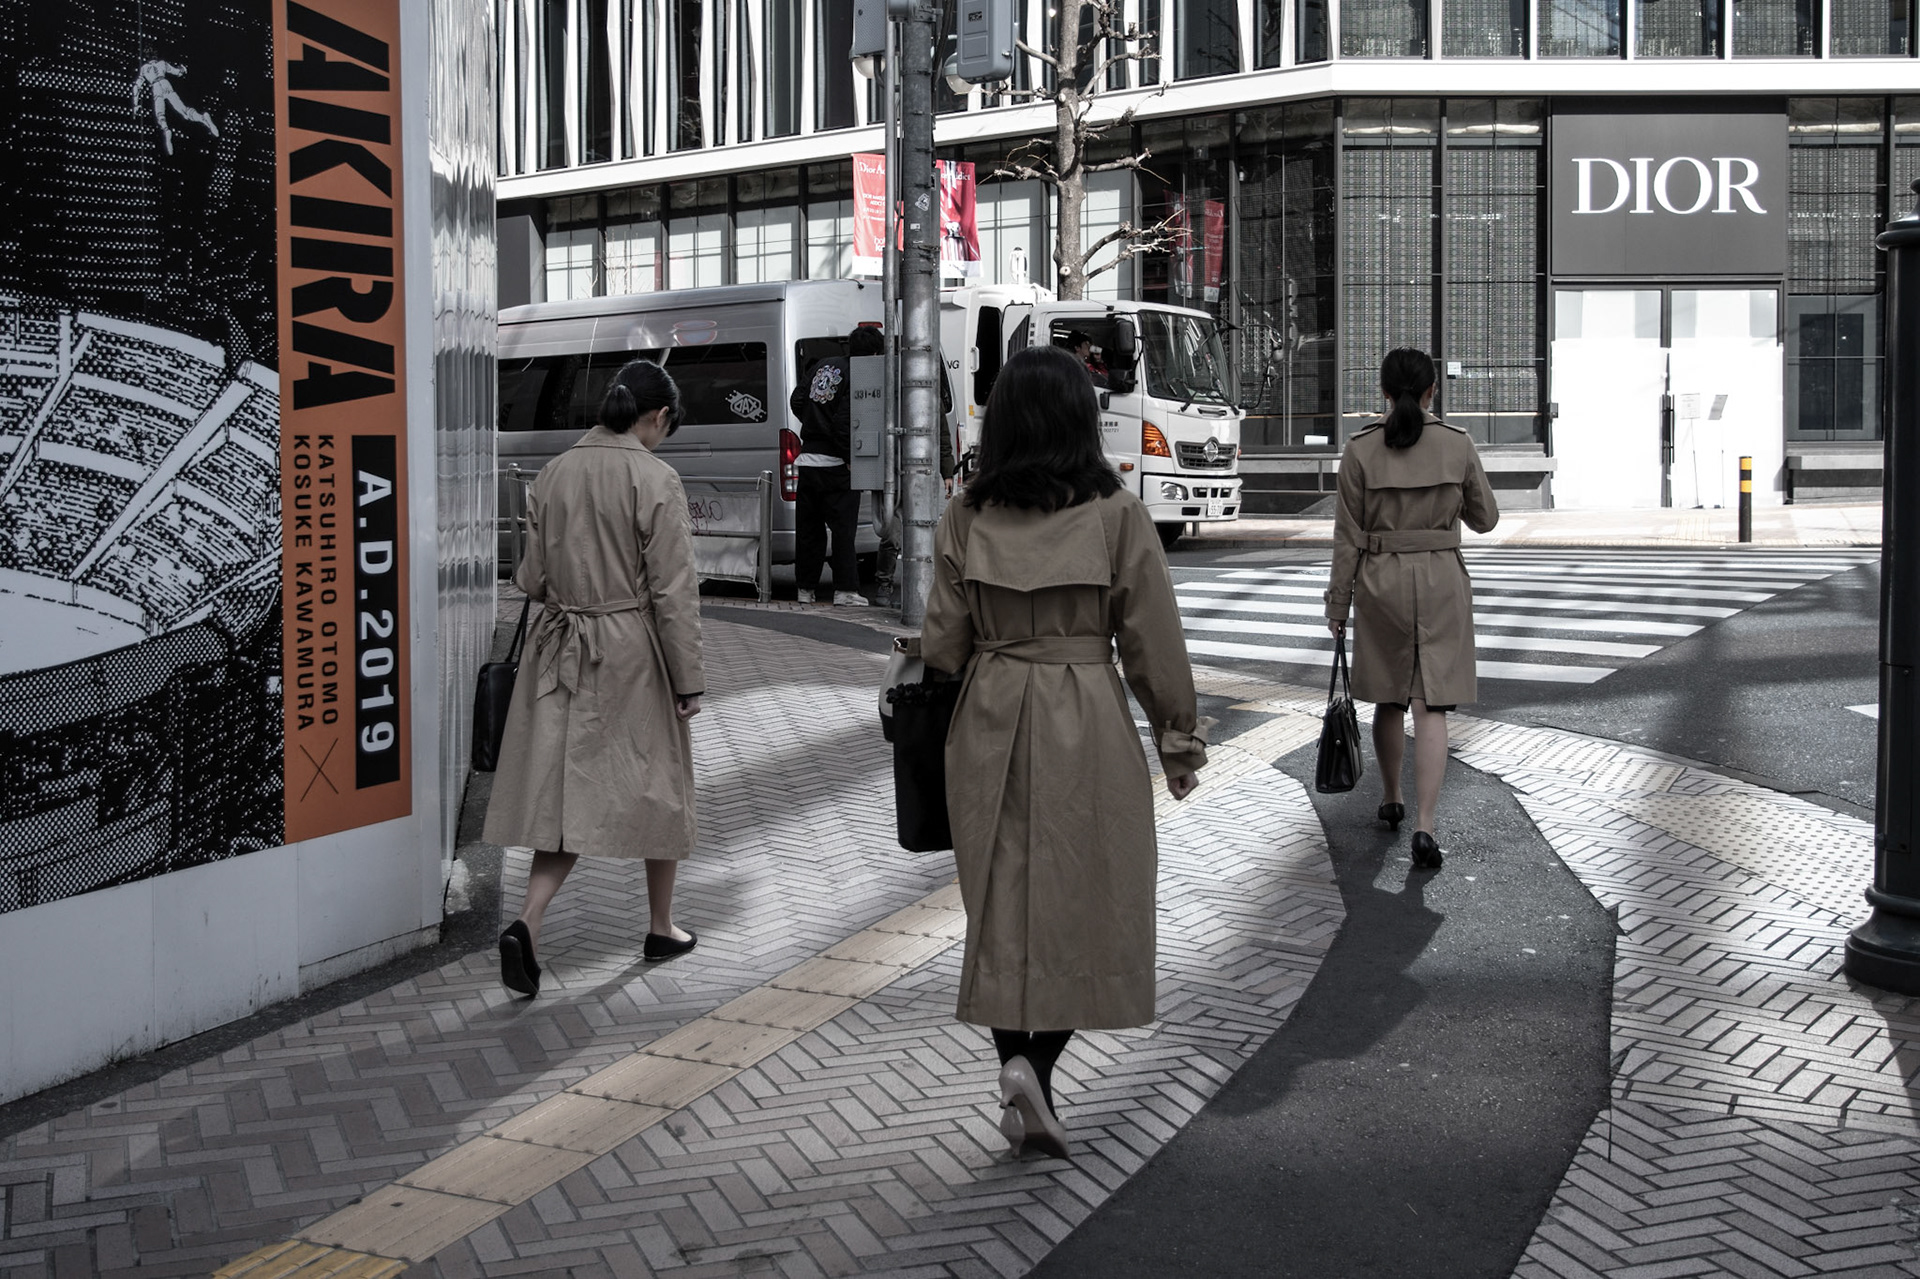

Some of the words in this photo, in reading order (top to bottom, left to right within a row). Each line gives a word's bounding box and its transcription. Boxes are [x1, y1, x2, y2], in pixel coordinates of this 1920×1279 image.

[286, 0, 396, 411] AKIRA
[859, 161, 876, 174] Dior
[1571, 156, 1768, 215] DIOR
[293, 434, 313, 548] KOSUKE
[317, 434, 338, 606] KATSUHIRO
[294, 561, 316, 731] KAWAMURA
[320, 620, 340, 726] OTOMO
[357, 468, 396, 754] A.D.2019
